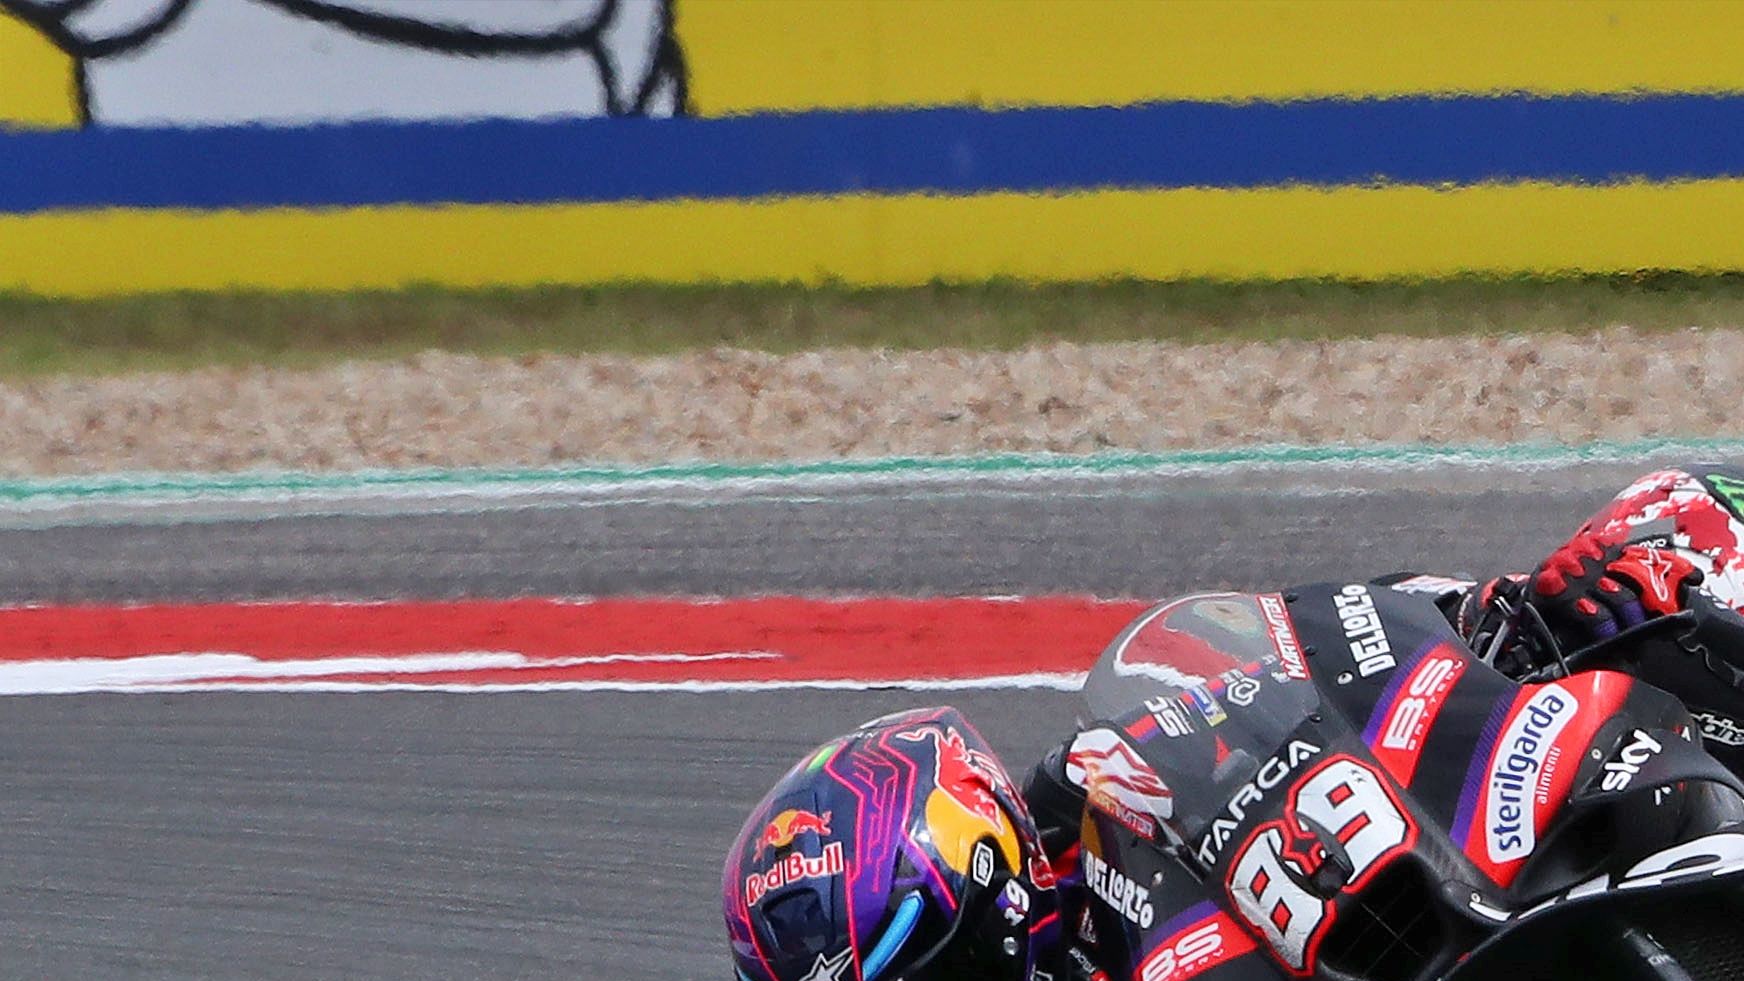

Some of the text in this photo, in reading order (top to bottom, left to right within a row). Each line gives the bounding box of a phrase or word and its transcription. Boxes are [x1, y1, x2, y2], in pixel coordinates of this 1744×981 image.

[1382, 658, 1454, 750] BS
[1198, 740, 1321, 865] TARGA
[1491, 693, 1565, 852] sterilgarda
[1535, 746, 1561, 805] alimenti
[1602, 729, 1663, 791] sky
[745, 841, 844, 907] Red Bull
[1228, 757, 1412, 971] 89
